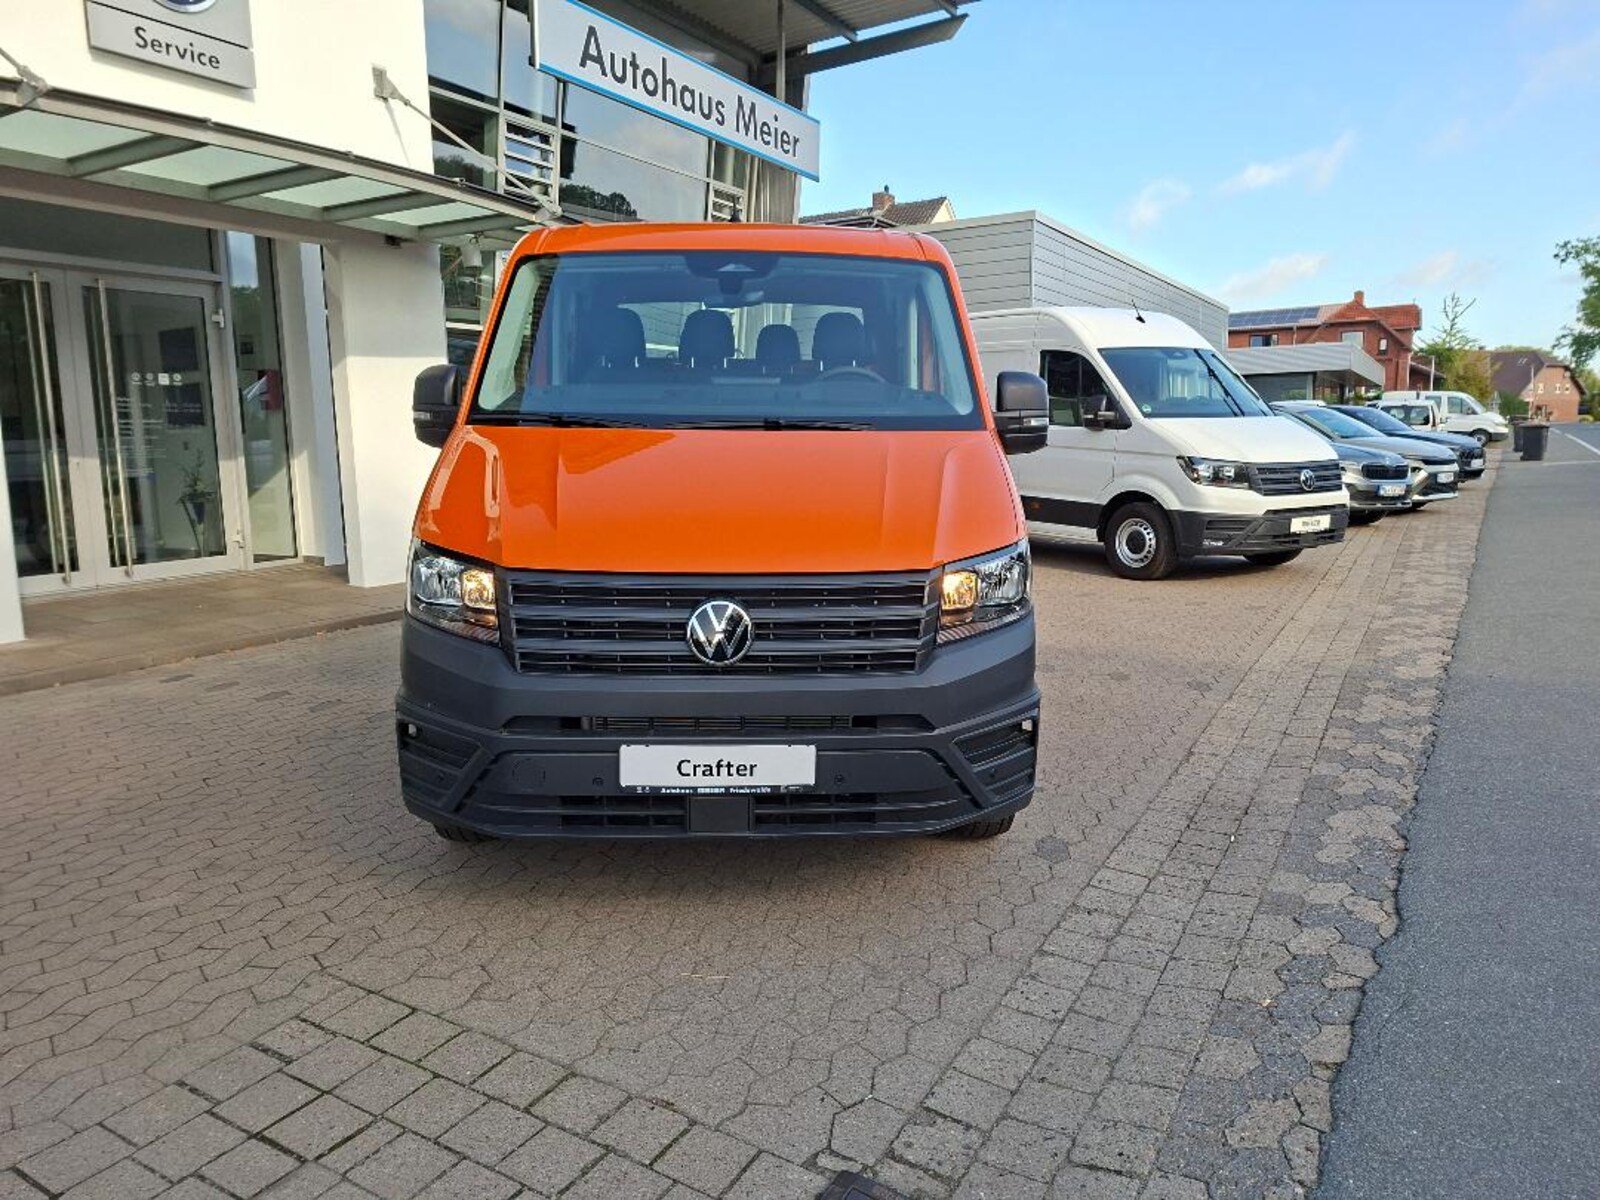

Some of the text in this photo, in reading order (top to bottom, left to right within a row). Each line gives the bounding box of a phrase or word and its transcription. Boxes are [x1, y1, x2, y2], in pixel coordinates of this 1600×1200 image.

[134, 26, 220, 69] Service
[579, 25, 800, 158] Autohaus Meier
[676, 759, 757, 777] Crafter
